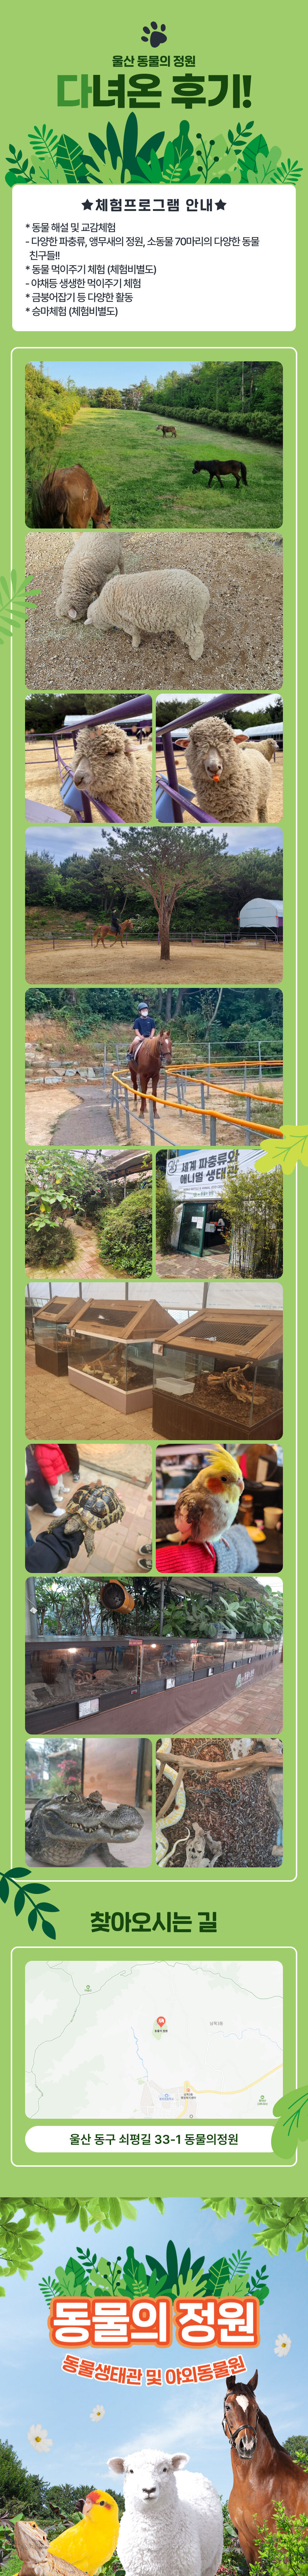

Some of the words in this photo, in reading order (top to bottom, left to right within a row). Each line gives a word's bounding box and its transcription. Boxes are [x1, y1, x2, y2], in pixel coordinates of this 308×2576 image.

[112, 56, 135, 67] 울산
[138, 56, 170, 67] 동물의
[174, 56, 195, 67] 정원
[57, 74, 162, 108] 다녀온
[172, 73, 251, 109] 후기!
[96, 199, 179, 211] 체험프로그램
[186, 199, 213, 211] 안내
[32, 223, 49, 232] 동물
[51, 223, 68, 232] 해설
[71, 223, 79, 232] 및
[81, 223, 115, 232] 교감체험
[32, 237, 58, 246] 다양한
[59, 237, 87, 247] 파충류,
[90, 237, 123, 246] 앵무새의
[126, 237, 145, 247] 정원,
[147, 237, 173, 246] 소동물
[175, 237, 212, 246] 70마리의
[215, 237, 240, 246] 다양한
[242, 237, 259, 246] 동물
[30, 251, 59, 260] 친구들!!
[32, 265, 49, 274] 동물
[52, 265, 85, 274] 먹이주기
[88, 265, 105, 274] 체험
[108, 265, 156, 275] (체험비별도)
[32, 279, 57, 288] 야채등
[59, 279, 86, 288] 생생한
[88, 279, 121, 288] 먹이주기
[124, 279, 140, 288] 체험
[32, 293, 74, 302] 금붕어잡기
[77, 293, 86, 302] 등
[88, 293, 114, 302] 다양한
[116, 293, 133, 302] 활동
[32, 307, 66, 316] 승마체험
[69, 307, 117, 317] (체험비별도)
[182, 1160, 196, 1172] 세계
[199, 1150, 240, 1168] 파충류와
[180, 1171, 203, 1184] 애니멀
[206, 1165, 239, 1181] 생태관
[91, 1912, 192, 1932] 찾아오시는
[198, 1912, 217, 1932] 길
[70, 2134, 91, 2145] 울산
[95, 2134, 115, 2145] 동구
[119, 2134, 150, 2145] 쇠평길
[155, 2135, 180, 2144] 33-1
[185, 2134, 238, 2145] 동물의정원
[53, 2302, 167, 2343] 동물의
[179, 2302, 255, 2343] 정원
[62, 2355, 142, 2385] 동물생태관
[146, 2369, 162, 2386] 및
[166, 2355, 246, 2385] 야외동물원
